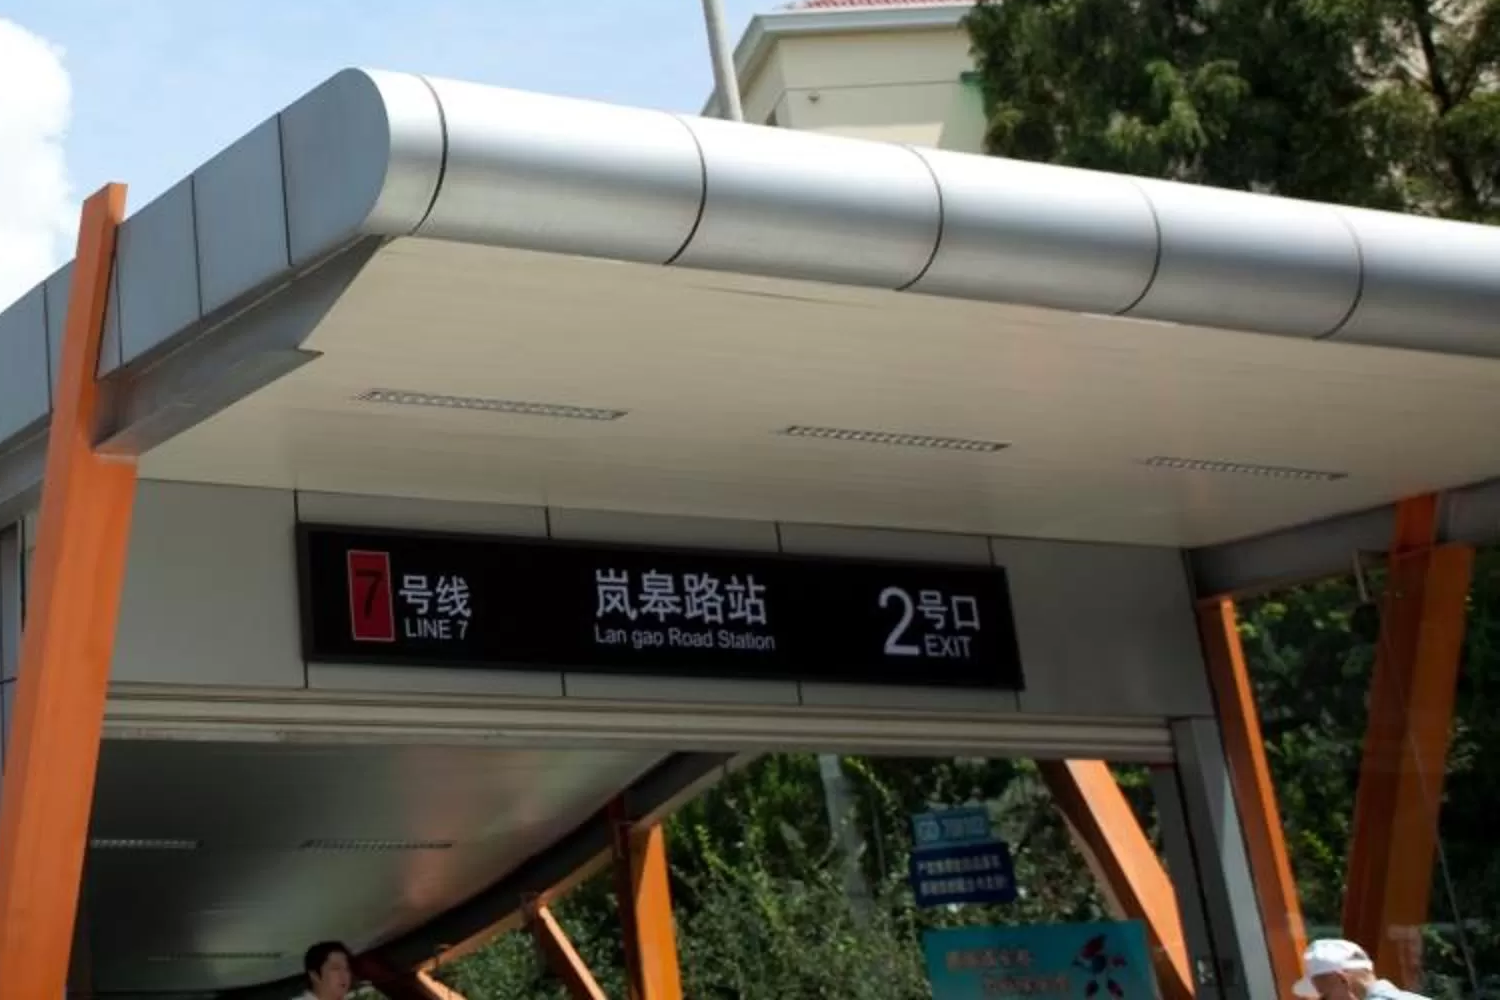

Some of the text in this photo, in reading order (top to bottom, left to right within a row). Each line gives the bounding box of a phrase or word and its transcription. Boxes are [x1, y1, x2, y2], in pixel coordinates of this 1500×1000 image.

[356, 569, 471, 619] 7 号线
[595, 568, 767, 625] 岚皋路站
[404, 618, 468, 640] LINE 7
[594, 623, 627, 644] Lan
[668, 627, 713, 648] Road
[717, 629, 776, 650] Station
[924, 633, 971, 657] EXIT
